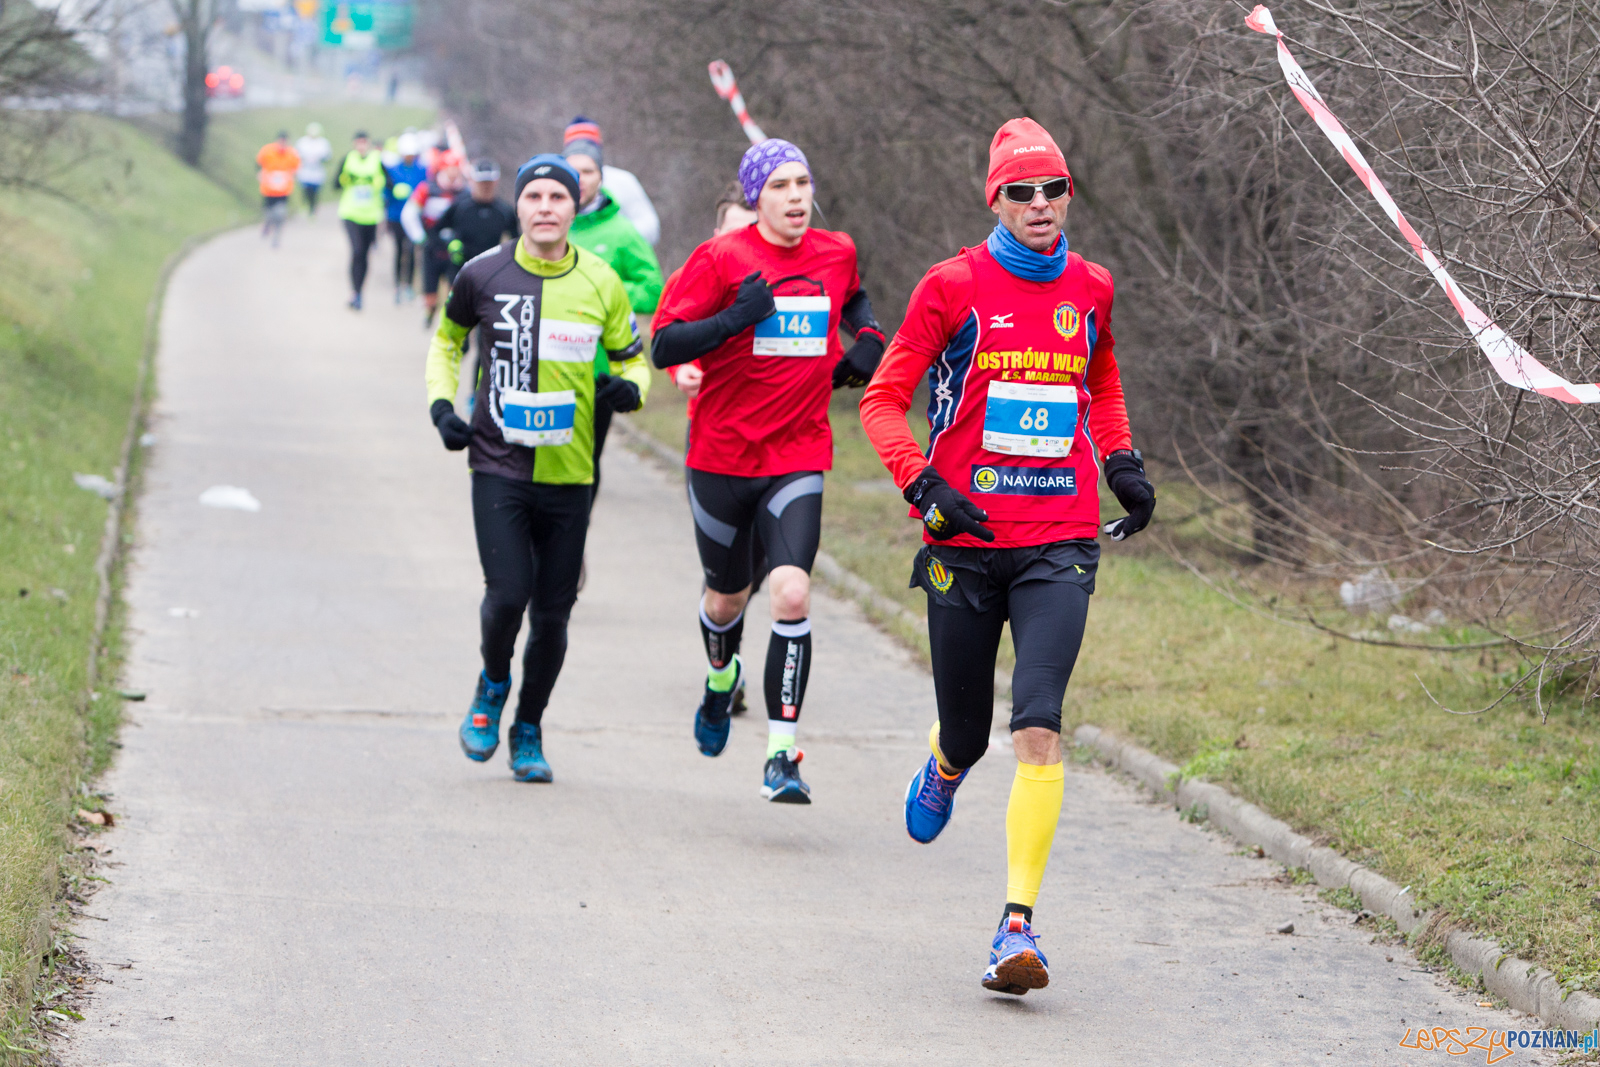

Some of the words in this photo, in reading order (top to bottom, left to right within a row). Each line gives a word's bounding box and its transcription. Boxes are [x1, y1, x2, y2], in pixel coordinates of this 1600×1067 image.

[1013, 145, 1047, 155] POLAND
[777, 314, 812, 335] 146
[548, 333, 593, 344] AQUILA
[977, 346, 1050, 370] OSTRÓW
[1001, 370, 1021, 381] K.S.
[1024, 370, 1072, 383] MARATON
[523, 409, 555, 428] 101
[1019, 407, 1049, 431] 68
[1003, 475, 1075, 488] NAVIGARE
